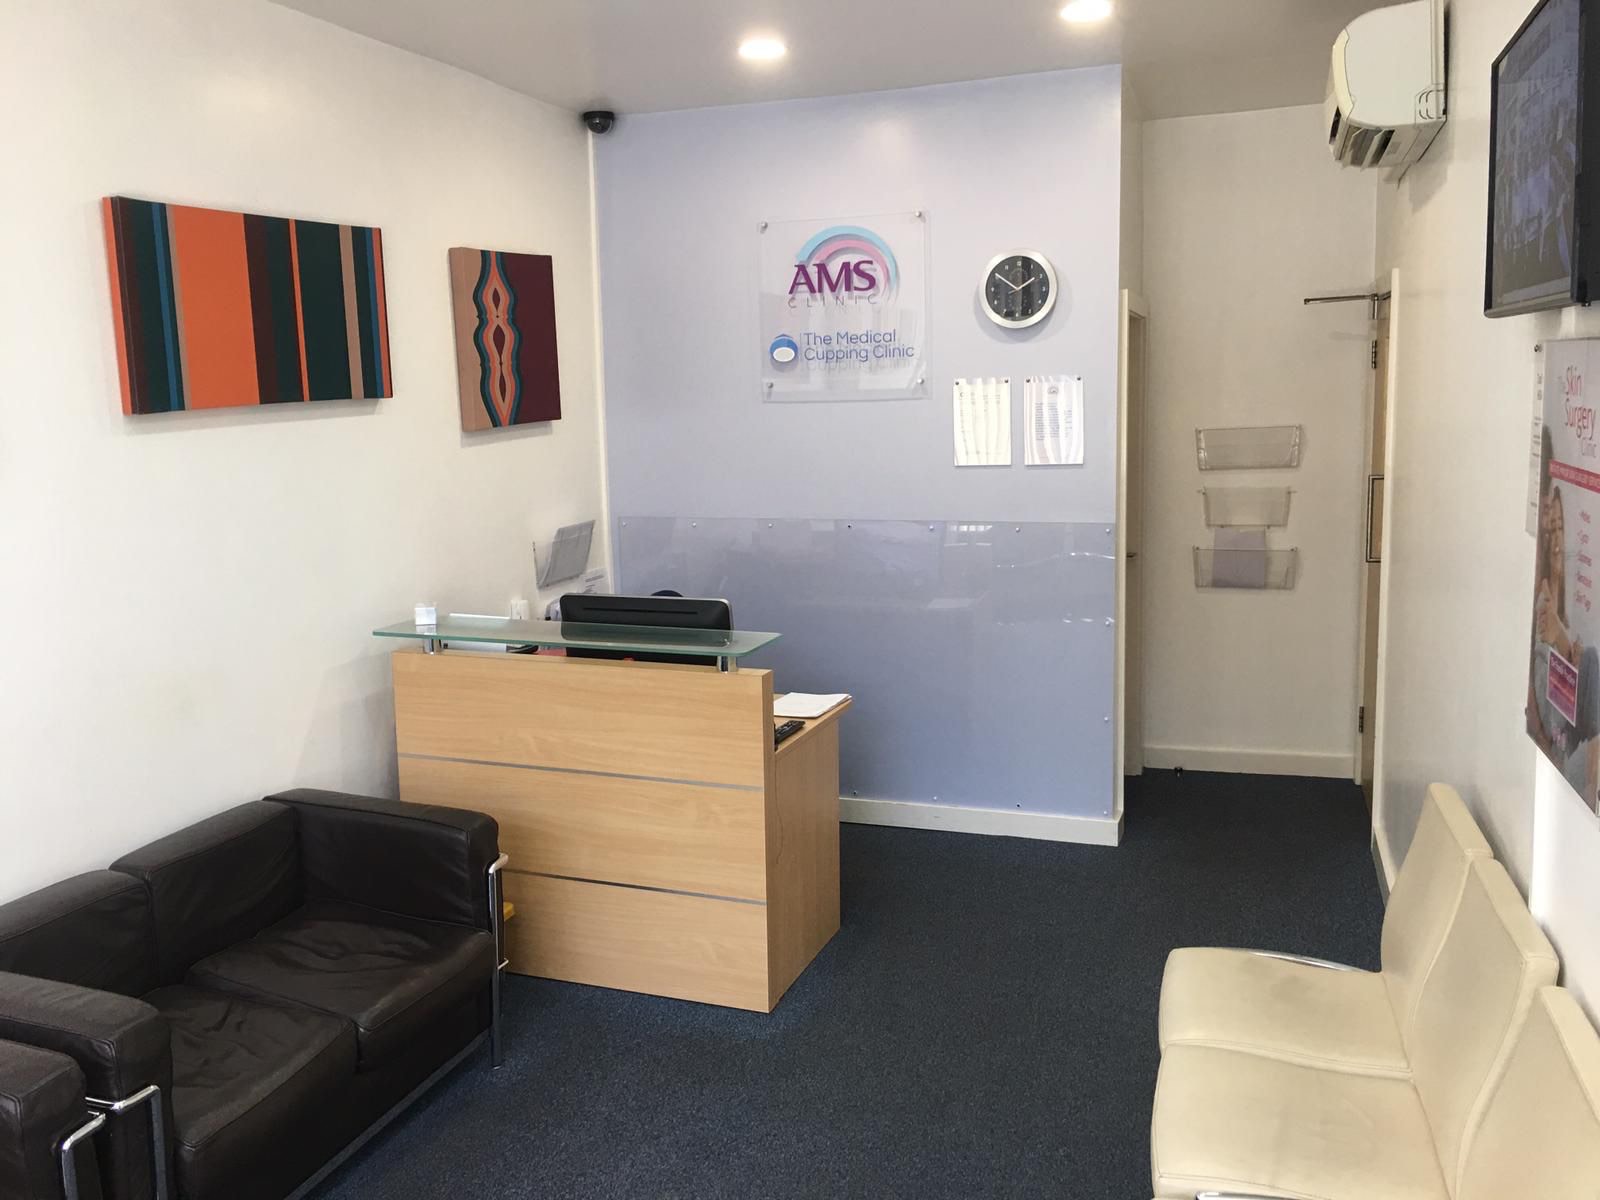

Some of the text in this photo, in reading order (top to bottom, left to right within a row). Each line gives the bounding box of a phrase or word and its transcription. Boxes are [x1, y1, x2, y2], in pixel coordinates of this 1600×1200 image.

[788, 260, 877, 295] AMS
[787, 294, 878, 309] CLINIC
[803, 328, 897, 346] The Medical
[803, 343, 915, 364] Cupping Clinic
[1564, 364, 1582, 396] Skin
[1563, 397, 1597, 440] Surgery
